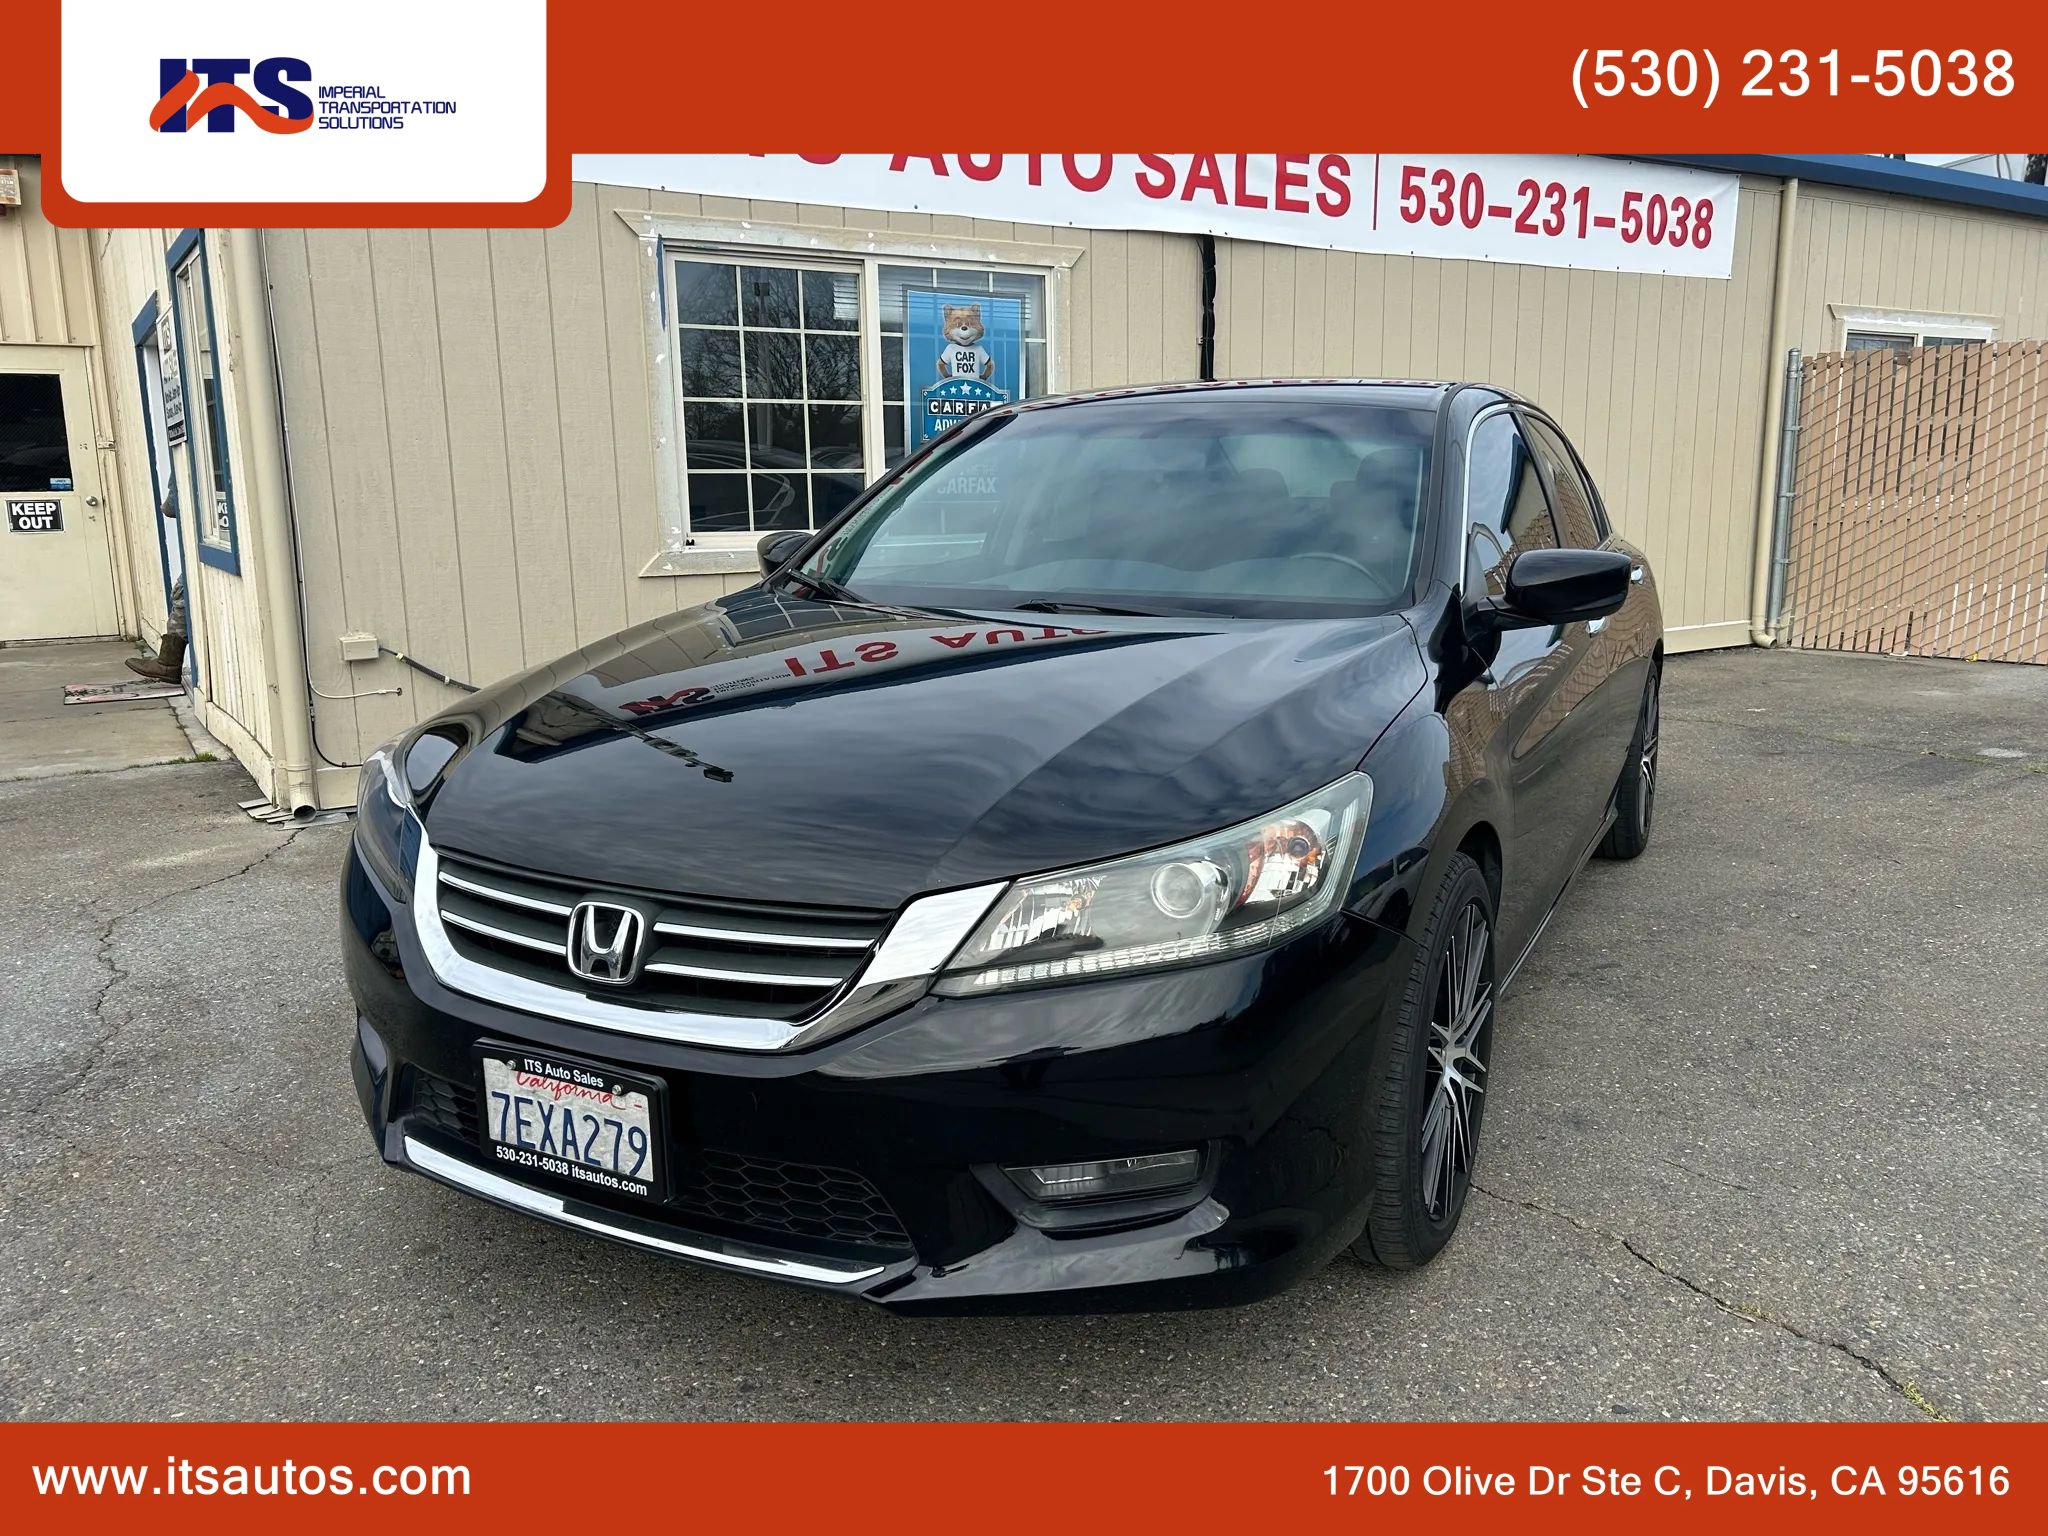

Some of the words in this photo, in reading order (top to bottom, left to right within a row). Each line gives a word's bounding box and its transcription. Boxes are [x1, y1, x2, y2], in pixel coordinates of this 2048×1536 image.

[1134, 153, 1351, 217] SALES
[1399, 164, 1714, 249] 530-231-5038
[955, 351, 975, 362] CAR
[956, 362, 975, 373] FOX
[930, 401, 988, 414] CARFA
[11, 503, 57, 515] KEEP
[18, 516, 53, 529] OUT
[524, 1058, 543, 1073] ITS
[544, 1063, 571, 1080] Auto
[572, 1069, 604, 1088] Sales
[491, 1091, 648, 1176] 7EXA279
[496, 1145, 569, 1176] 530-231-5038
[571, 1165, 648, 1196] itsautos.com
